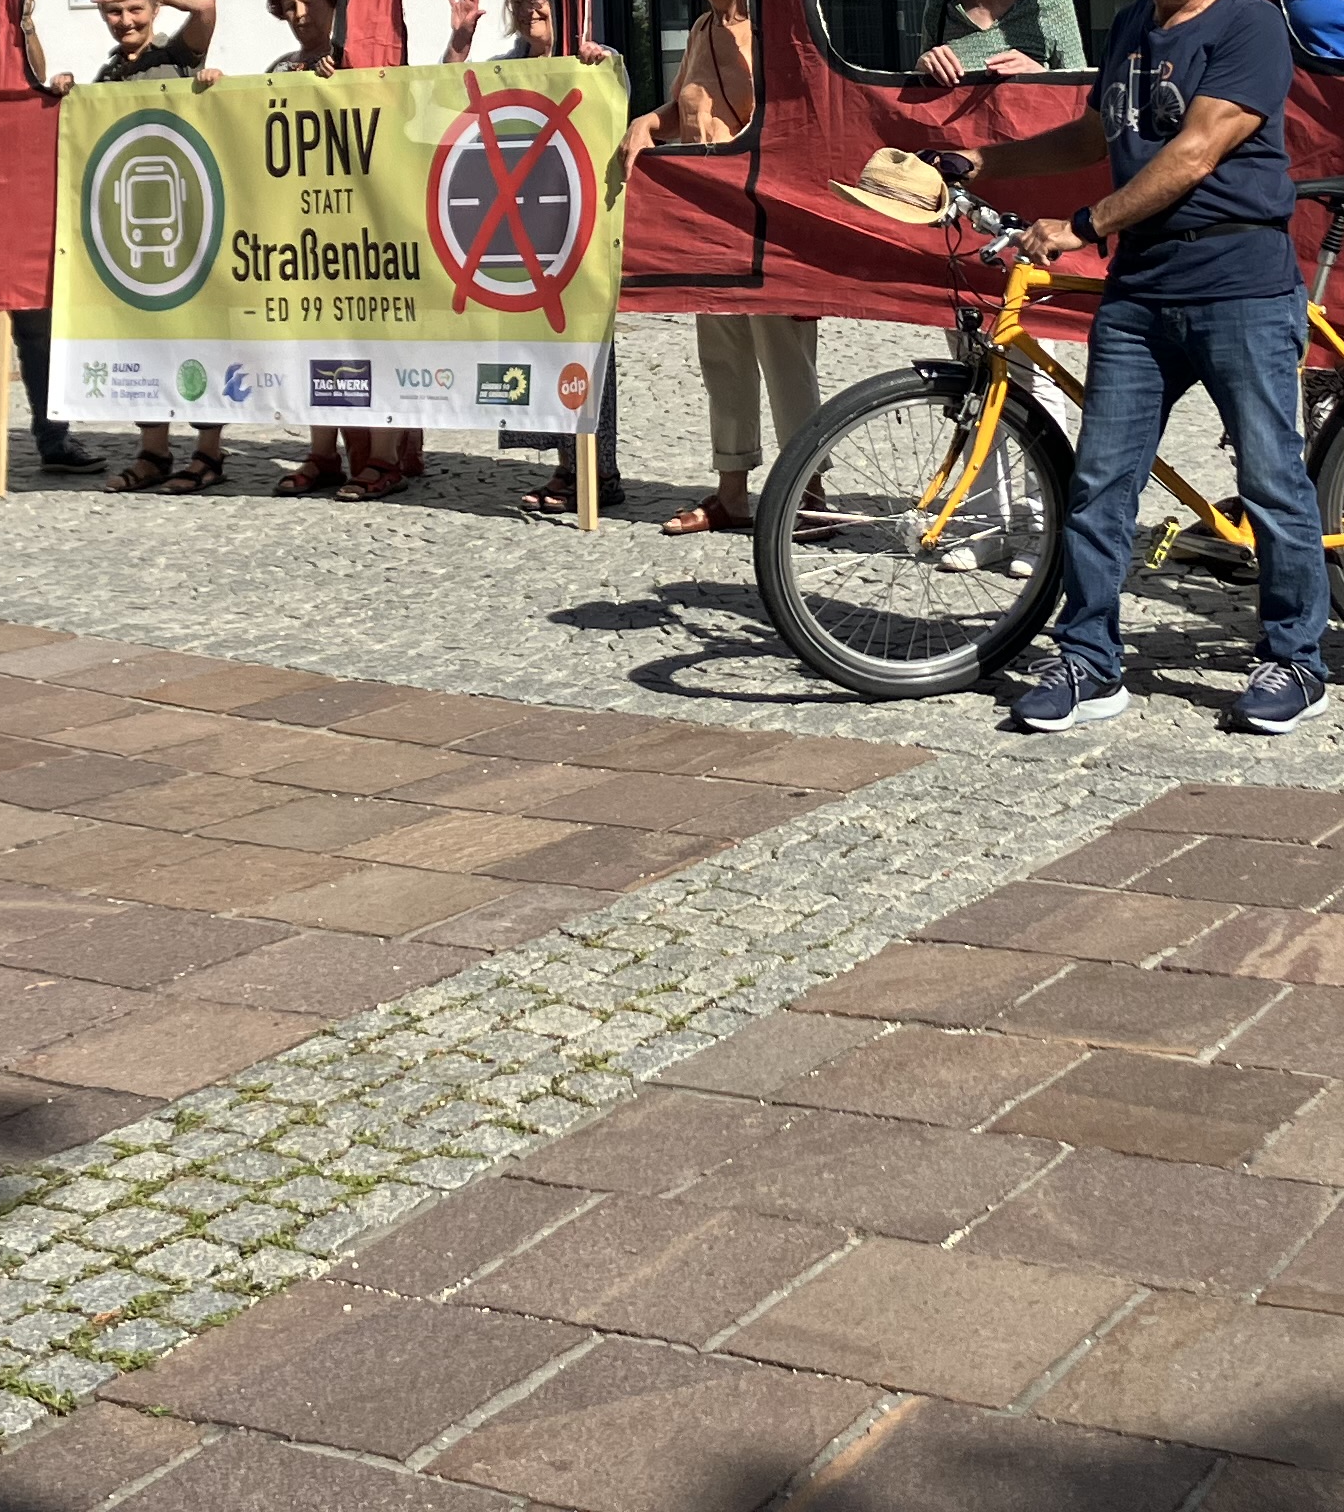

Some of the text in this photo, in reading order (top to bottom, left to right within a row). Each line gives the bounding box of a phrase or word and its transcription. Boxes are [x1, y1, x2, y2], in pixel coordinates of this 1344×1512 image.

[264, 97, 382, 179] ÖPNV
[300, 187, 354, 215] STATT
[231, 226, 421, 282] Straßenbau
[265, 296, 289, 323] ED
[300, 295, 323, 322] 99
[332, 295, 417, 322] STOPPEN
[111, 363, 141, 373] BUND
[256, 372, 285, 387] LBV
[395, 368, 433, 388] VCD
[561, 376, 586, 396] ödp
